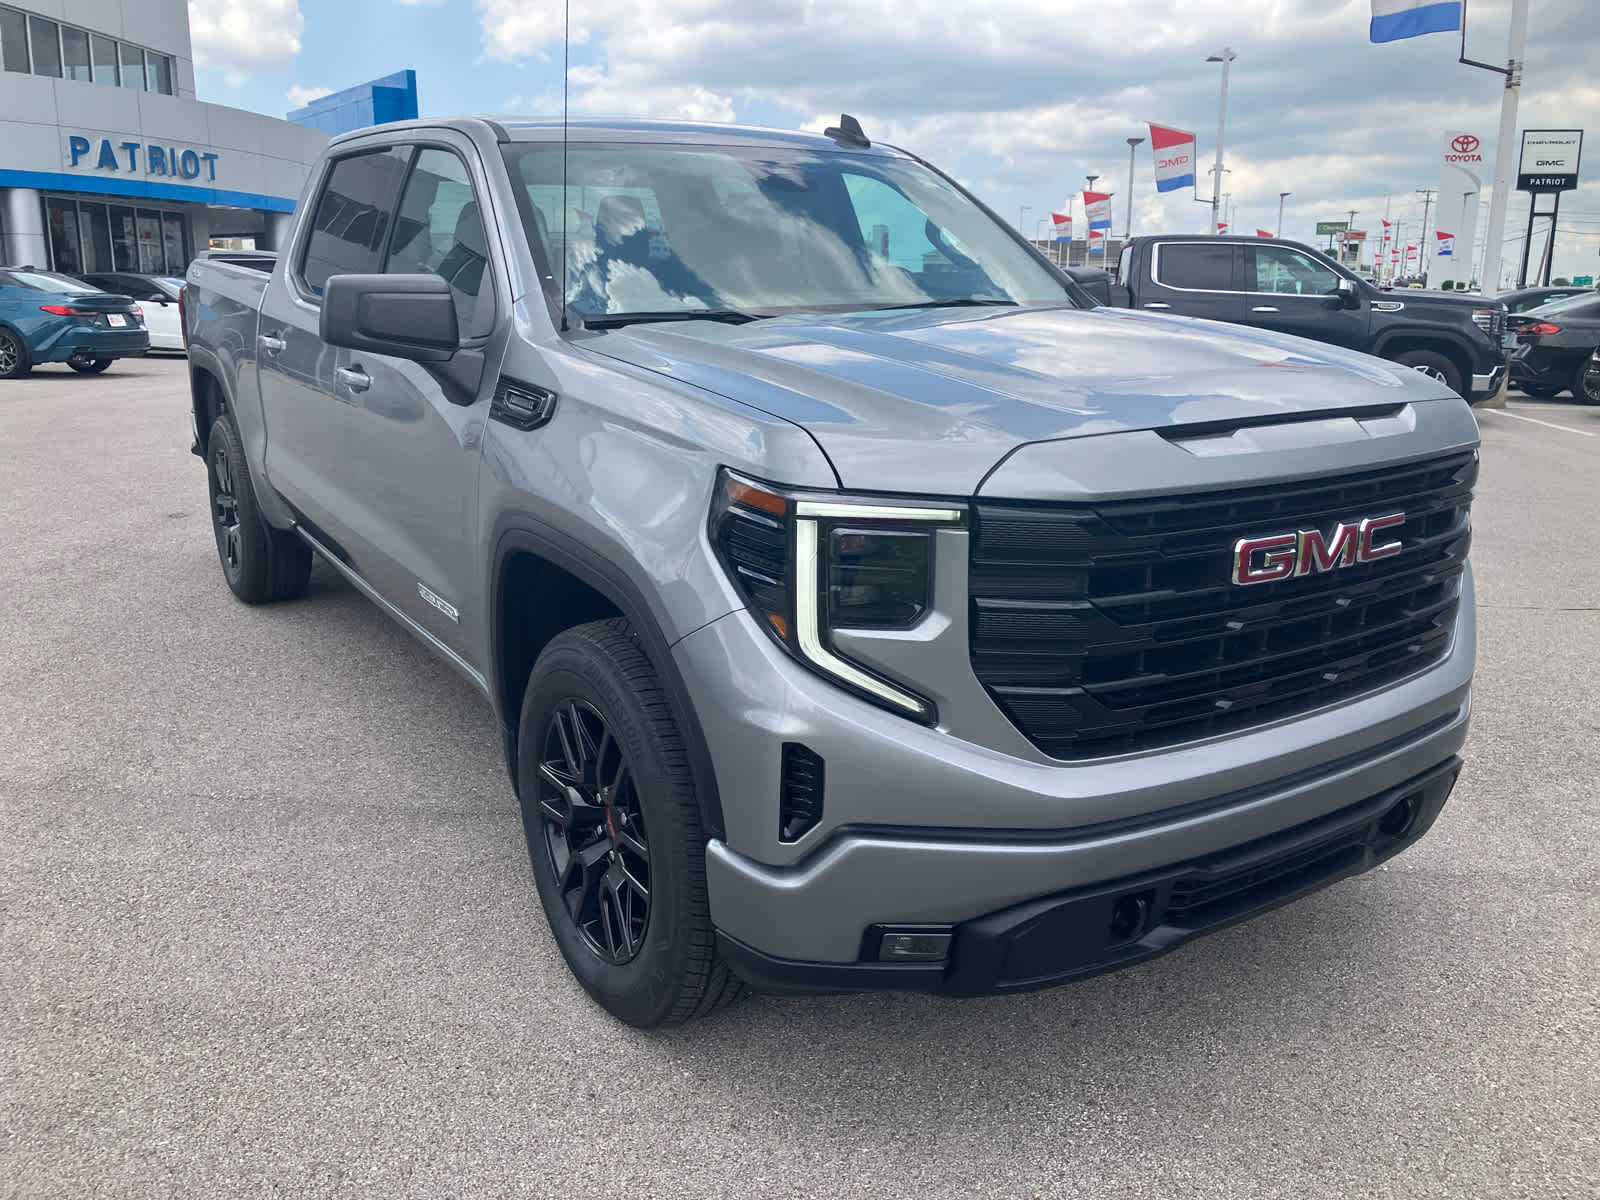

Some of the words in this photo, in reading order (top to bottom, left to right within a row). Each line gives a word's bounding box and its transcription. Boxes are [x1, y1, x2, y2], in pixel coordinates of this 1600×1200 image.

[69, 135, 219, 181] PATRIOT
[1444, 154, 1482, 163] TOYOTA
[1232, 512, 1406, 586] GMC
